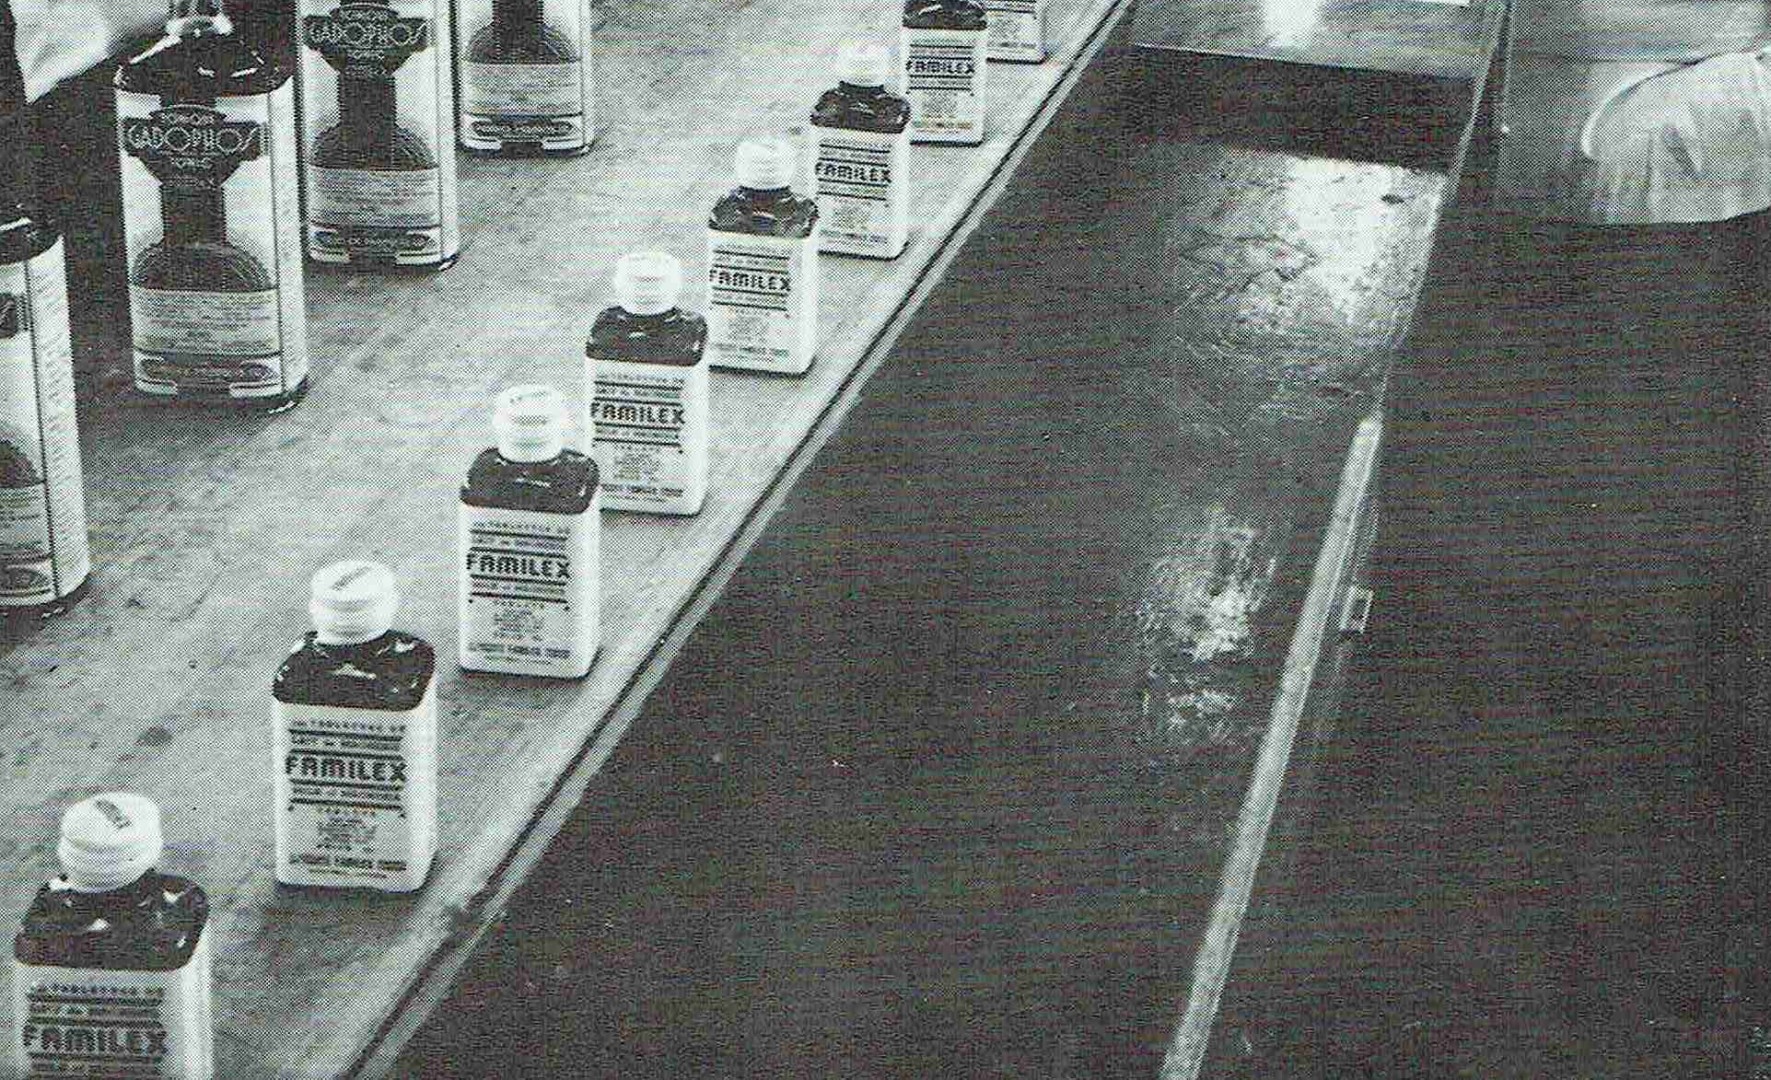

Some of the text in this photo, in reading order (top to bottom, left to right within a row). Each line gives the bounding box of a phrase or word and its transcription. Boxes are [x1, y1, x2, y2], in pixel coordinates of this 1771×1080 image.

[905, 60, 975, 75] FAMILEX
[814, 162, 892, 184] FAMILEX
[709, 269, 791, 292] FAMILEX
[590, 401, 686, 425] FAMILEX
[466, 554, 571, 579] FAMILEX
[285, 755, 407, 782] FAMILEX
[22, 1024, 168, 1054] FAMILEX
